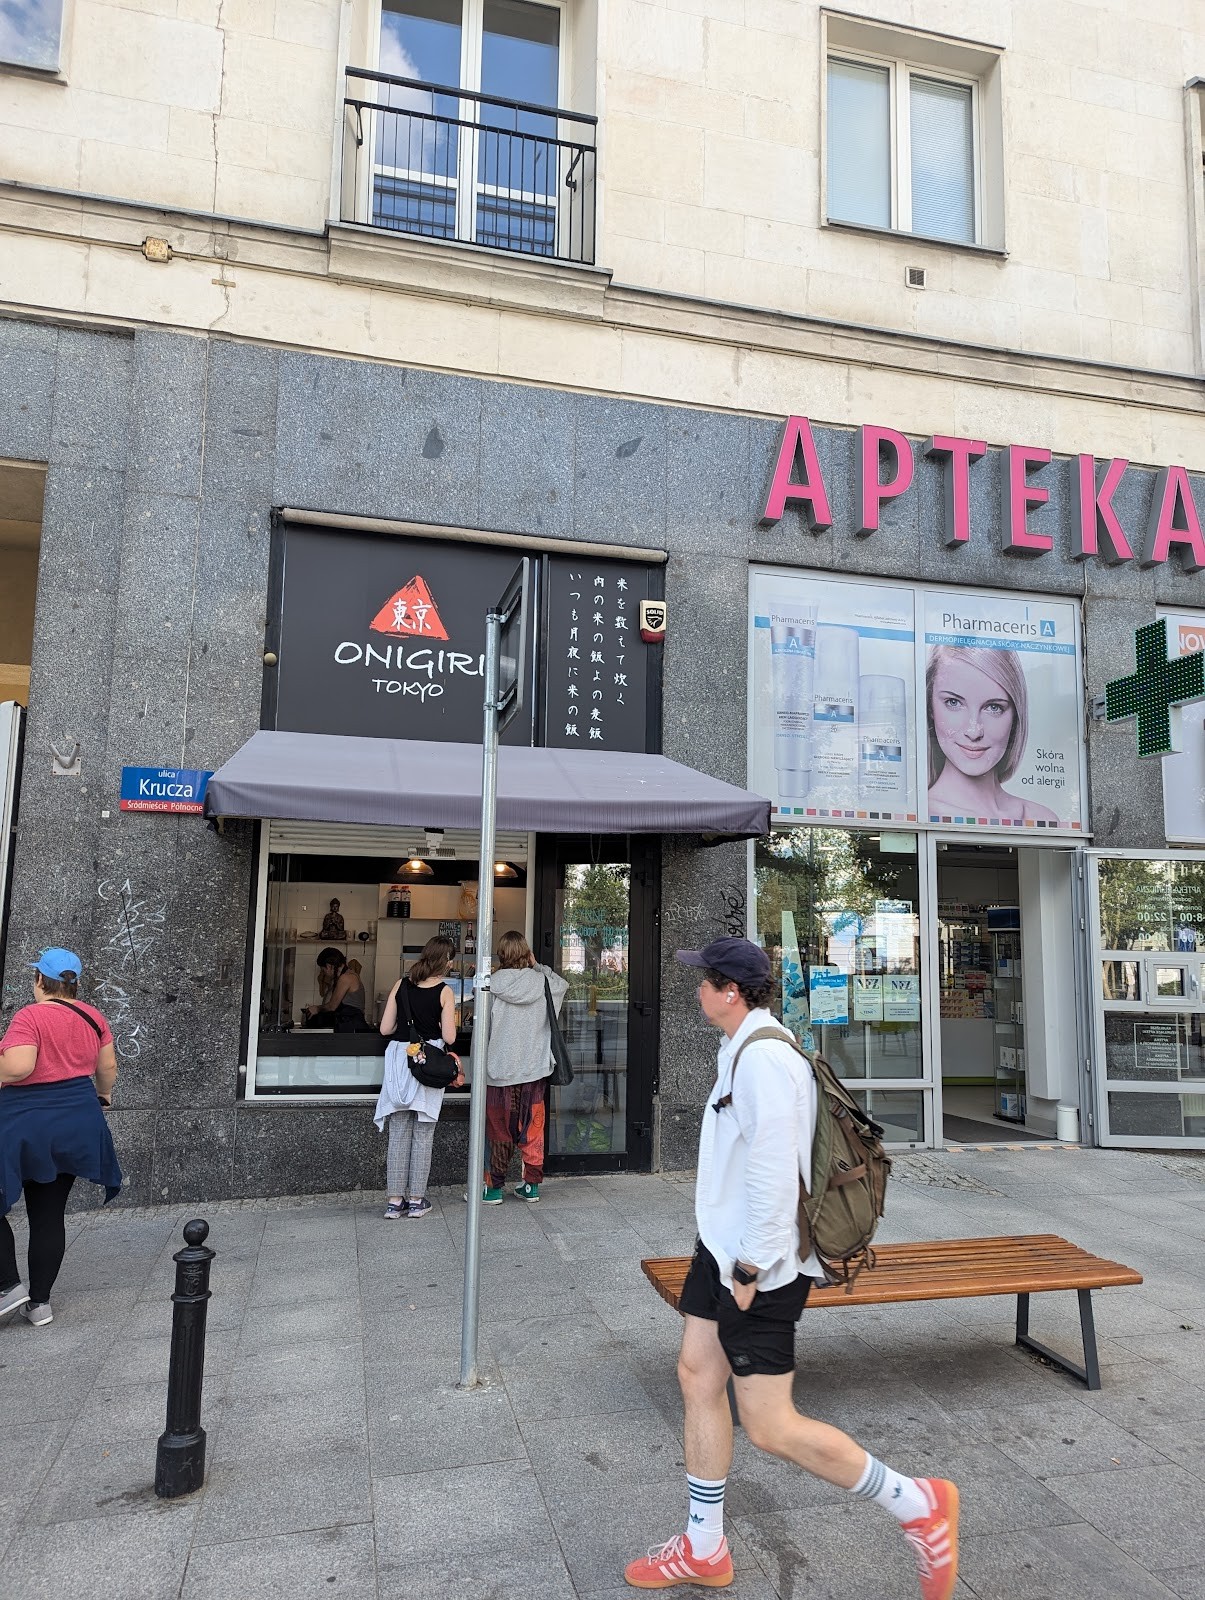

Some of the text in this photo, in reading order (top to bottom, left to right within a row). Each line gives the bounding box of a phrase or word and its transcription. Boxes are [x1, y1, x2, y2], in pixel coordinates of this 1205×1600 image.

[757, 414, 1205, 571] APTEKA
[390, 597, 432, 633] 東京
[771, 614, 815, 626] Pharmaceris
[942, 611, 1037, 636] Pharmaceris
[929, 635, 997, 648] DERMOPIELĘGNACJA
[334, 641, 485, 678] ONIGIRI
[371, 678, 444, 704] TOKYO
[1036, 748, 1064, 760] Skóra
[158, 770, 175, 778] ulica
[1035, 763, 1065, 774] wolna
[139, 778, 193, 798] Krucza
[1021, 775, 1066, 789] od alergii
[127, 800, 168, 810] Śródmieście
[439, 921, 457, 930] ZIMNE
[856, 978, 880, 989] NFZ
[891, 980, 912, 990] NFZ
